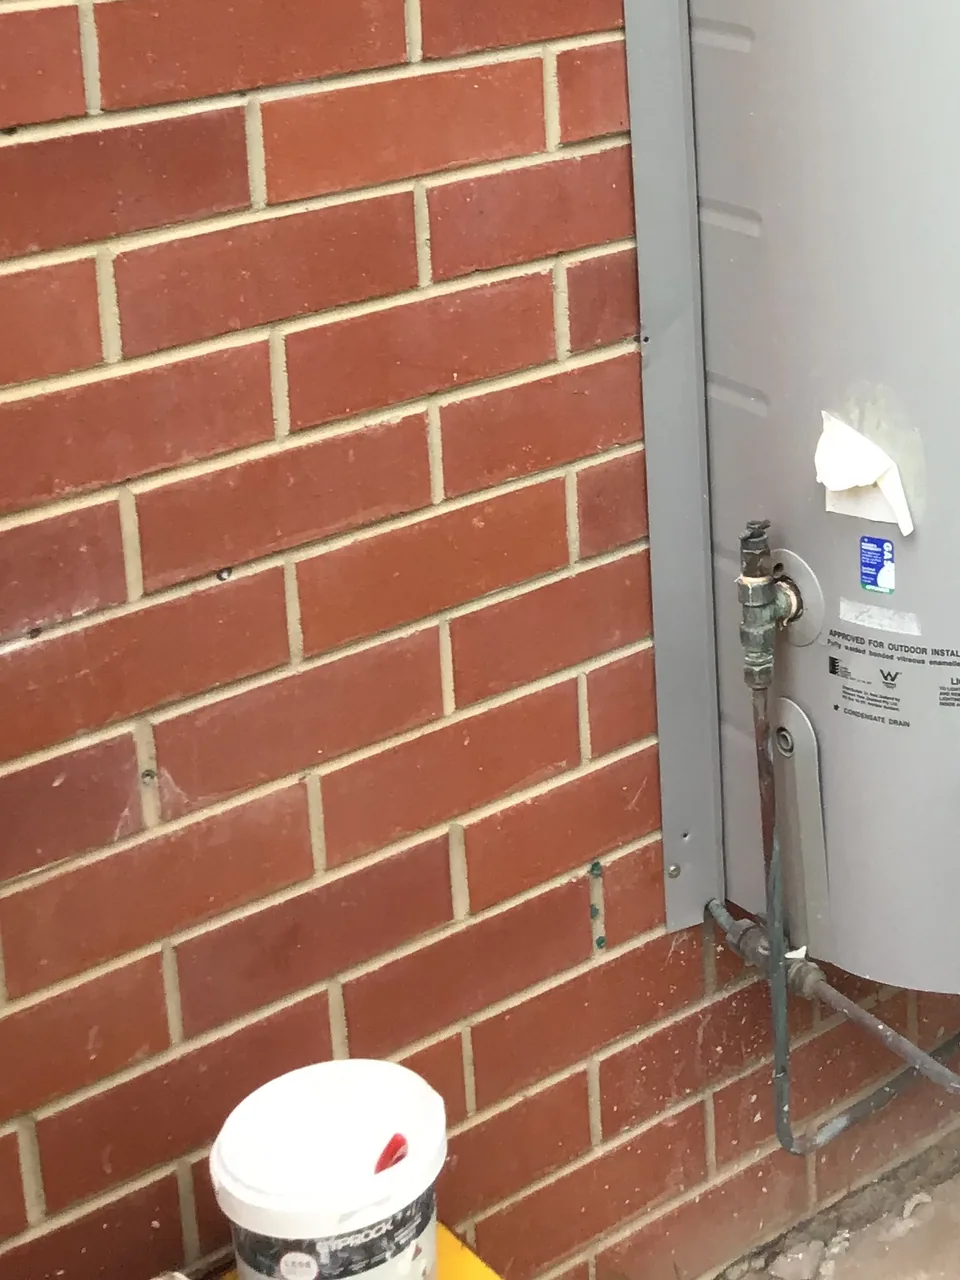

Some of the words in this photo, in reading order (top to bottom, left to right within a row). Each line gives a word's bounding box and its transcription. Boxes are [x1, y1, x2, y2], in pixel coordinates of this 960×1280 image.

[828, 629, 865, 645] APPROVED
[868, 639, 884, 649] FOR
[888, 643, 927, 655] OUTDOOR
[844, 645, 866, 654] welded
[869, 650, 894, 660] bonded
[897, 656, 925, 664] vitreous
[843, 707, 885, 723] CONDENSATE
[888, 718, 910, 727] DRAIN
